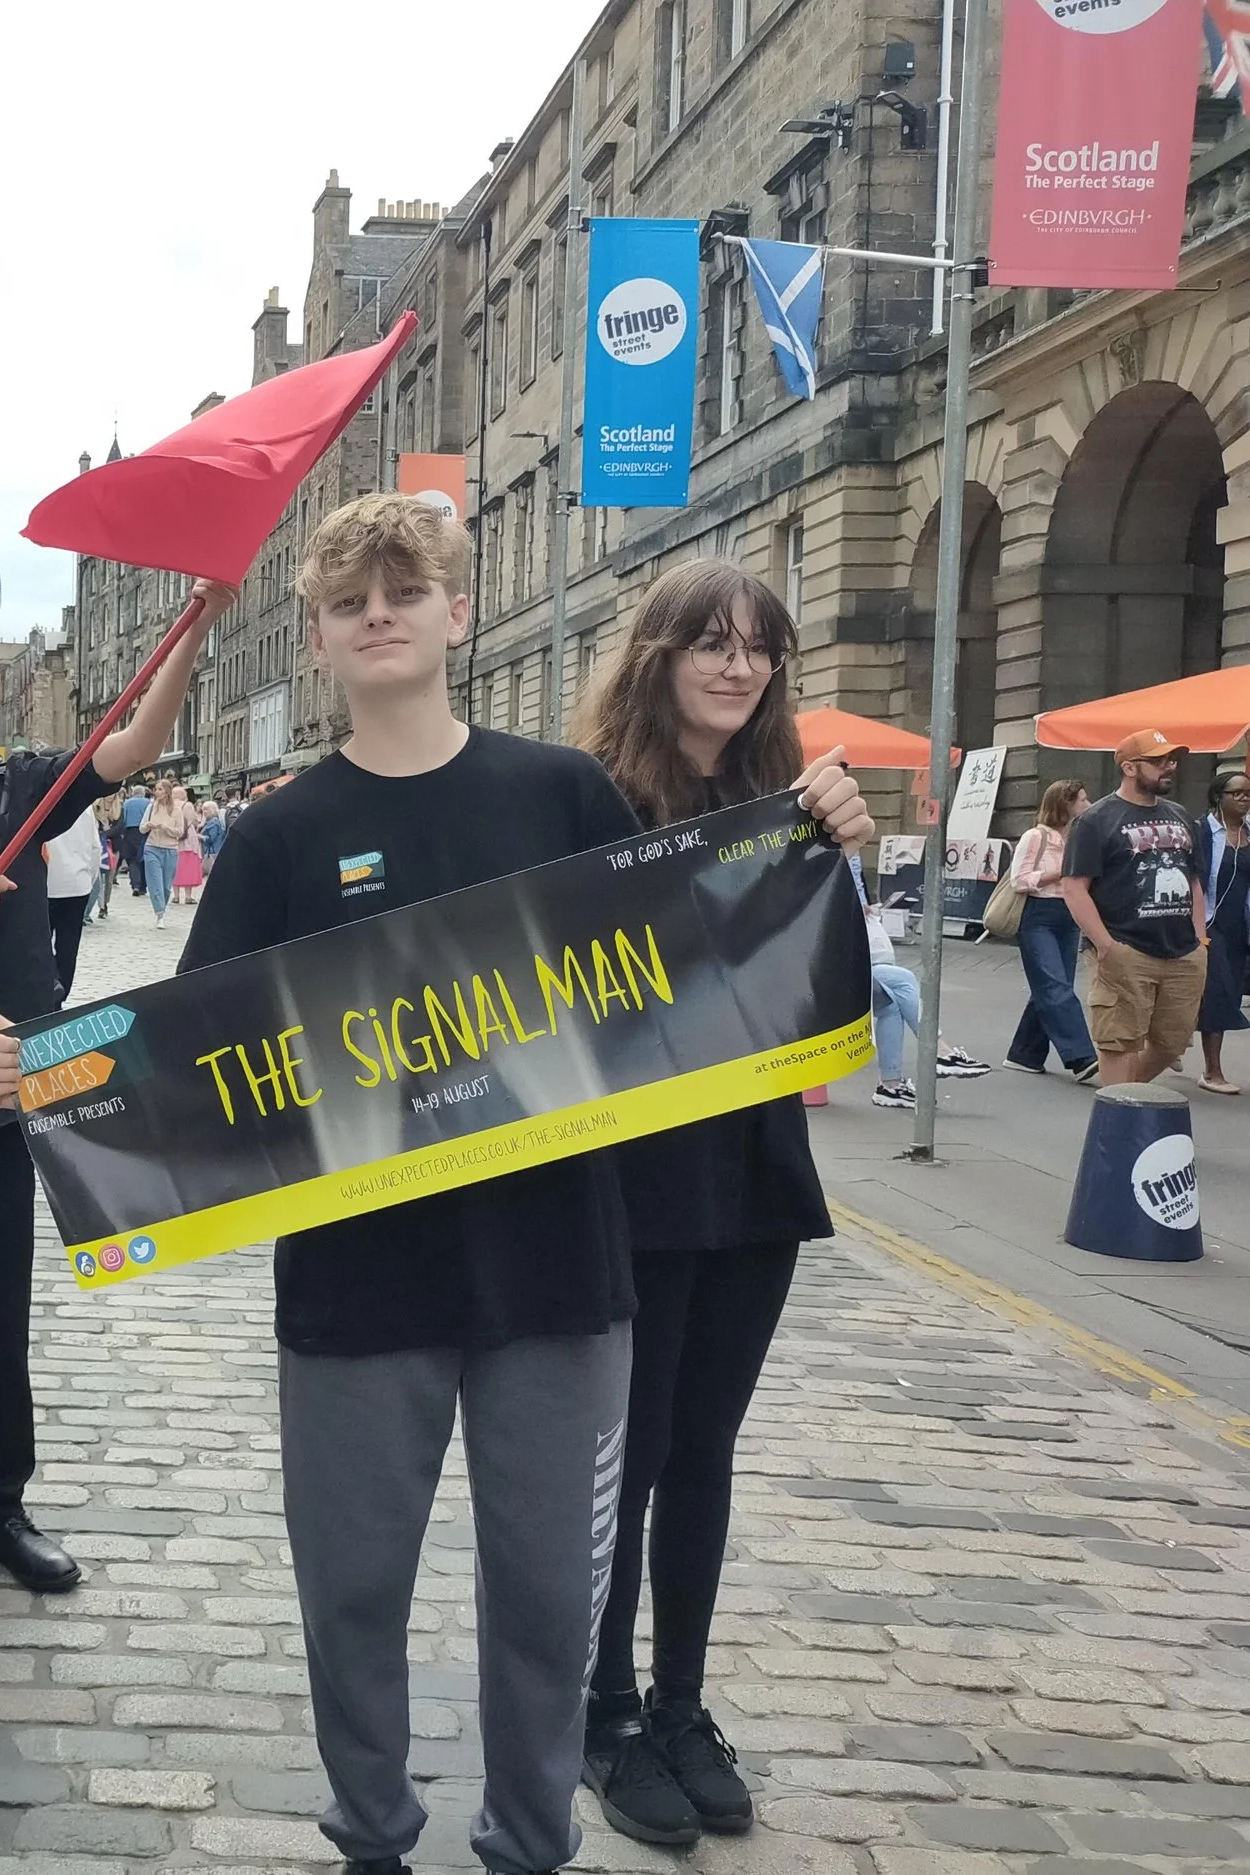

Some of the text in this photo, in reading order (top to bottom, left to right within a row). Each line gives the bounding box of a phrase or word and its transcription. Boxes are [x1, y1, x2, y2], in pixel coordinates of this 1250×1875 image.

[1025, 140, 1160, 172] Scotland
[1025, 174, 1155, 191] The Perfect Stage
[604, 304, 679, 339] fringe
[612, 334, 646, 348] street
[614, 342, 651, 356] events
[600, 423, 675, 442] Scotland
[600, 443, 674, 453] The Perfect Stage
[638, 838, 673, 863] GOD'S
[675, 828, 708, 851] SAKE,
[718, 839, 755, 865] CLEAR
[757, 830, 786, 852] THE
[362, 881, 386, 893] PRESENTS
[754, 1031, 864, 1074] at theSpace on the
[25, 1058, 97, 1105] PLACES
[195, 1025, 323, 1125] THE
[411, 1074, 491, 1114] 14-19 AUGUST
[28, 1096, 126, 1135] ENSEMBLE PRESENTS
[1159, 1194, 1190, 1216] street
[1163, 1201, 1194, 1224] events
